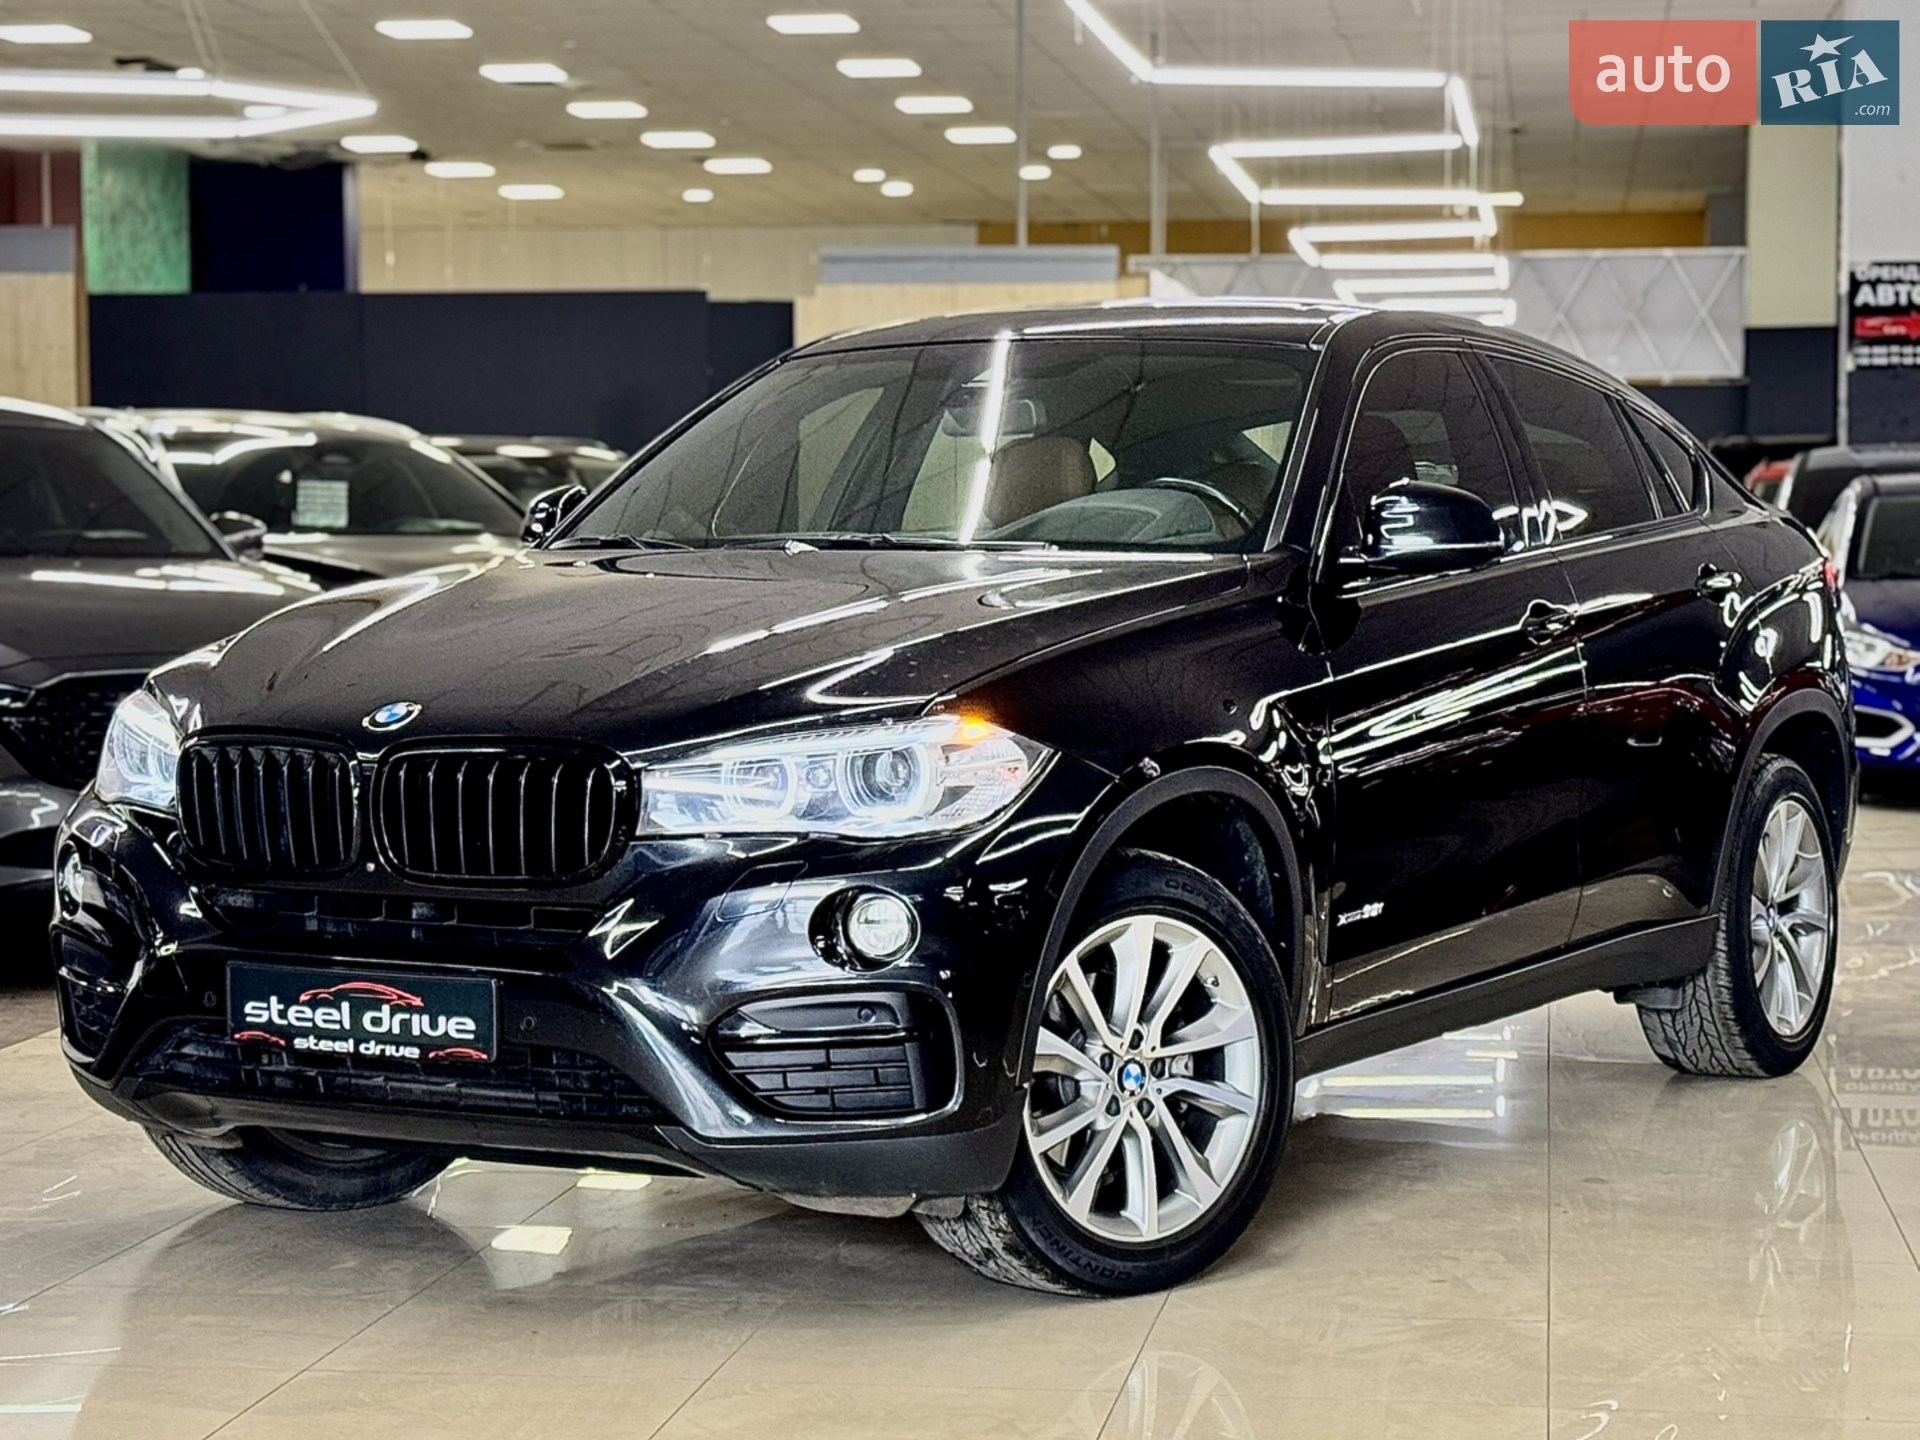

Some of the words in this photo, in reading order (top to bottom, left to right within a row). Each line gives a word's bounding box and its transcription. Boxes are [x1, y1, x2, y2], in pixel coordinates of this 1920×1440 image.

[1854, 264, 1920, 282] ОРЕНД
[244, 995, 351, 1030] steel
[362, 1004, 477, 1040] drive
[293, 1035, 354, 1054] steel
[358, 1040, 420, 1059] drive
